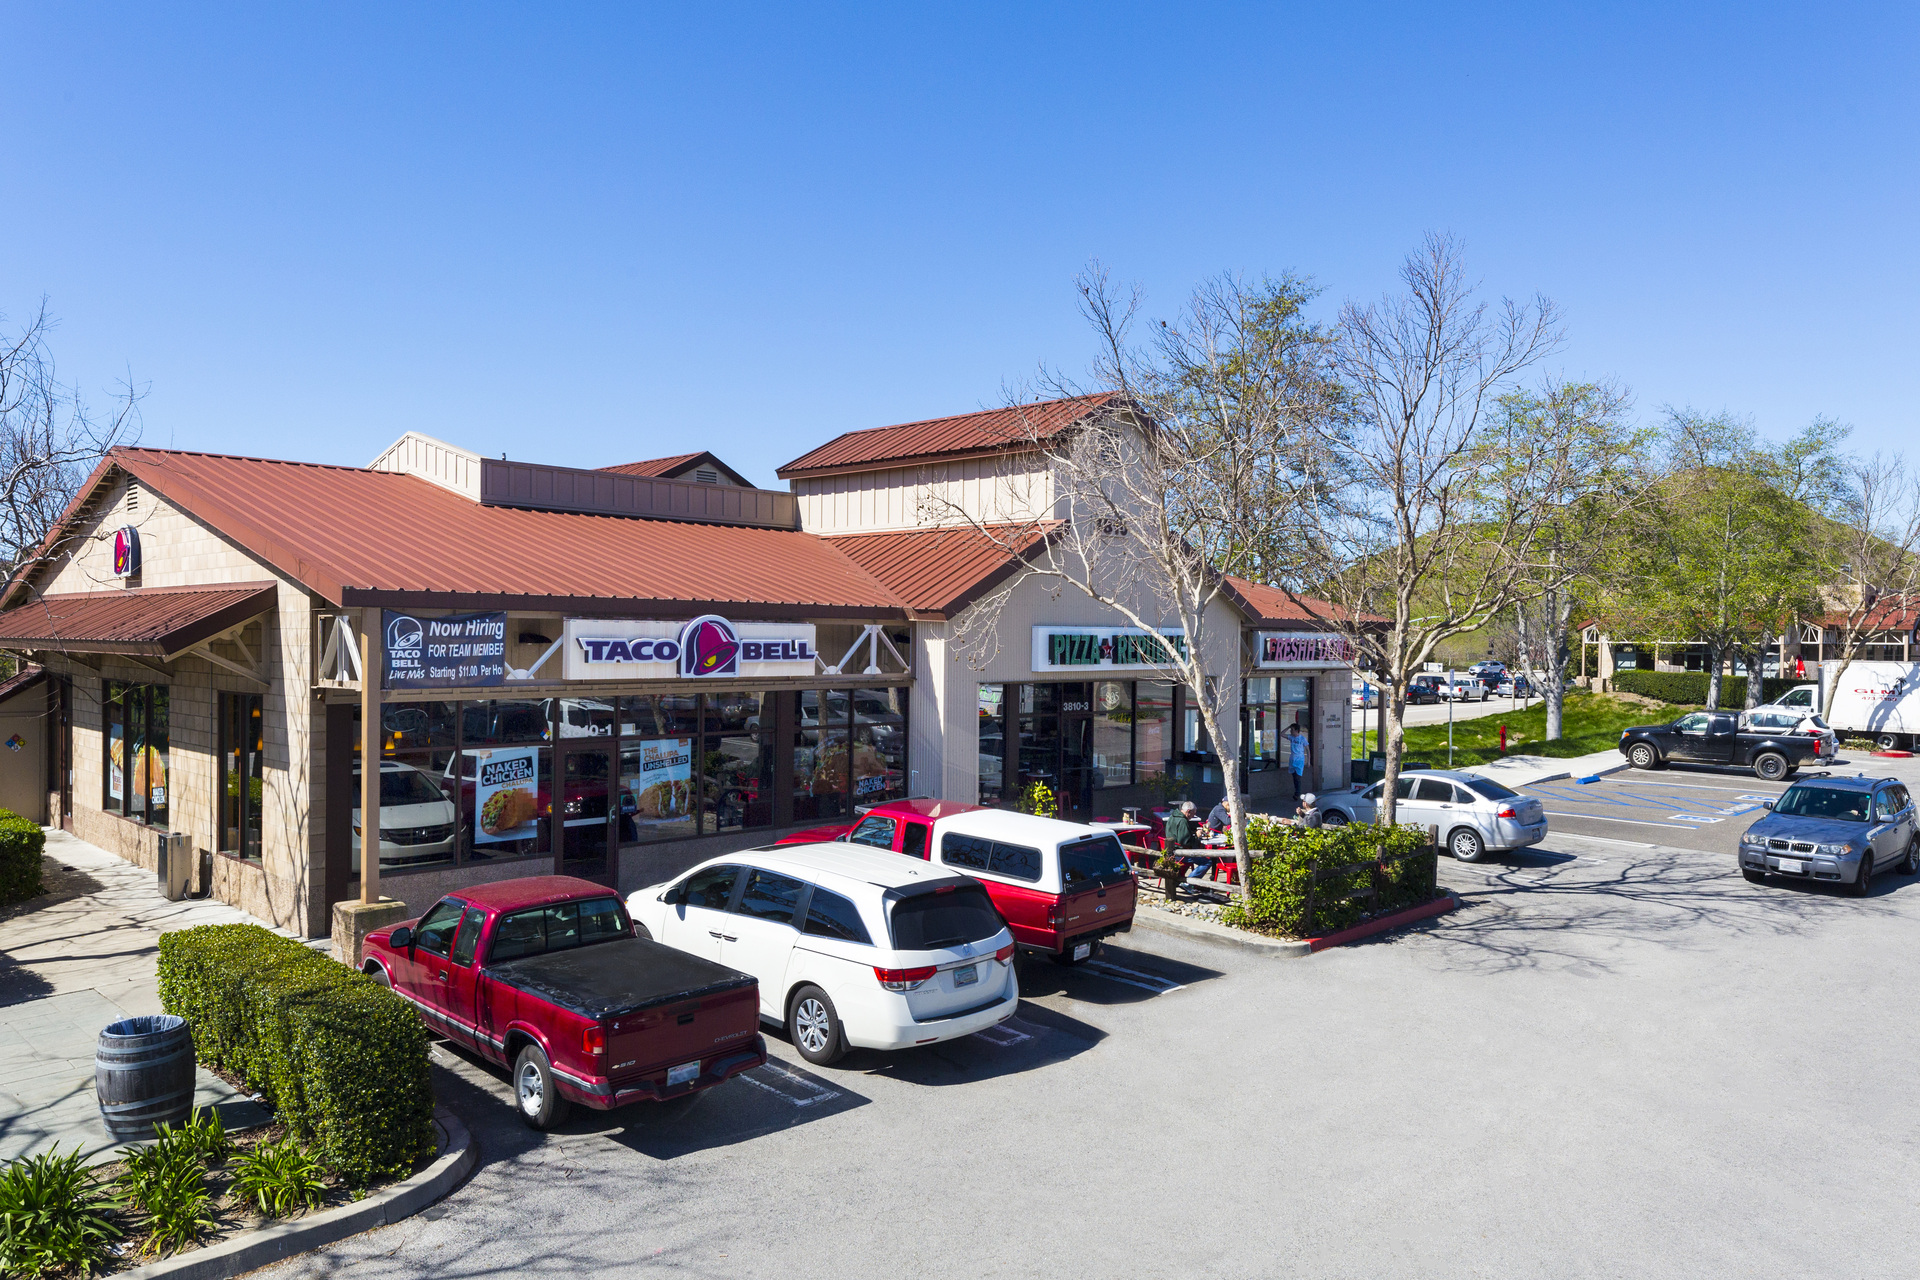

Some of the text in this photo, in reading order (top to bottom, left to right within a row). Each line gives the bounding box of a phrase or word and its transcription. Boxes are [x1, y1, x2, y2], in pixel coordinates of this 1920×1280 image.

[429, 618, 504, 640] Now Hiring
[389, 650, 420, 658] TACO
[428, 644, 446, 658] FOR
[448, 643, 471, 657] TEAM
[585, 640, 815, 661] TACO BELL
[1054, 634, 1100, 665] PIZZA
[1269, 638, 1316, 661] FRESHH
[391, 659, 421, 668] BELL
[429, 666, 456, 680] Starting
[458, 665, 478, 677] $11.00
[481, 665, 491, 676] Per
[1063, 702, 1089, 711] 3810-3
[643, 746, 658, 756] THE
[643, 749, 679, 763] CHALUPA
[486, 759, 527, 775] NAKED
[482, 767, 533, 786] CHICKEN
[501, 777, 534, 789] CHALUPA
[858, 776, 883, 787] NAKED
[856, 782, 886, 795] CHICKEN
